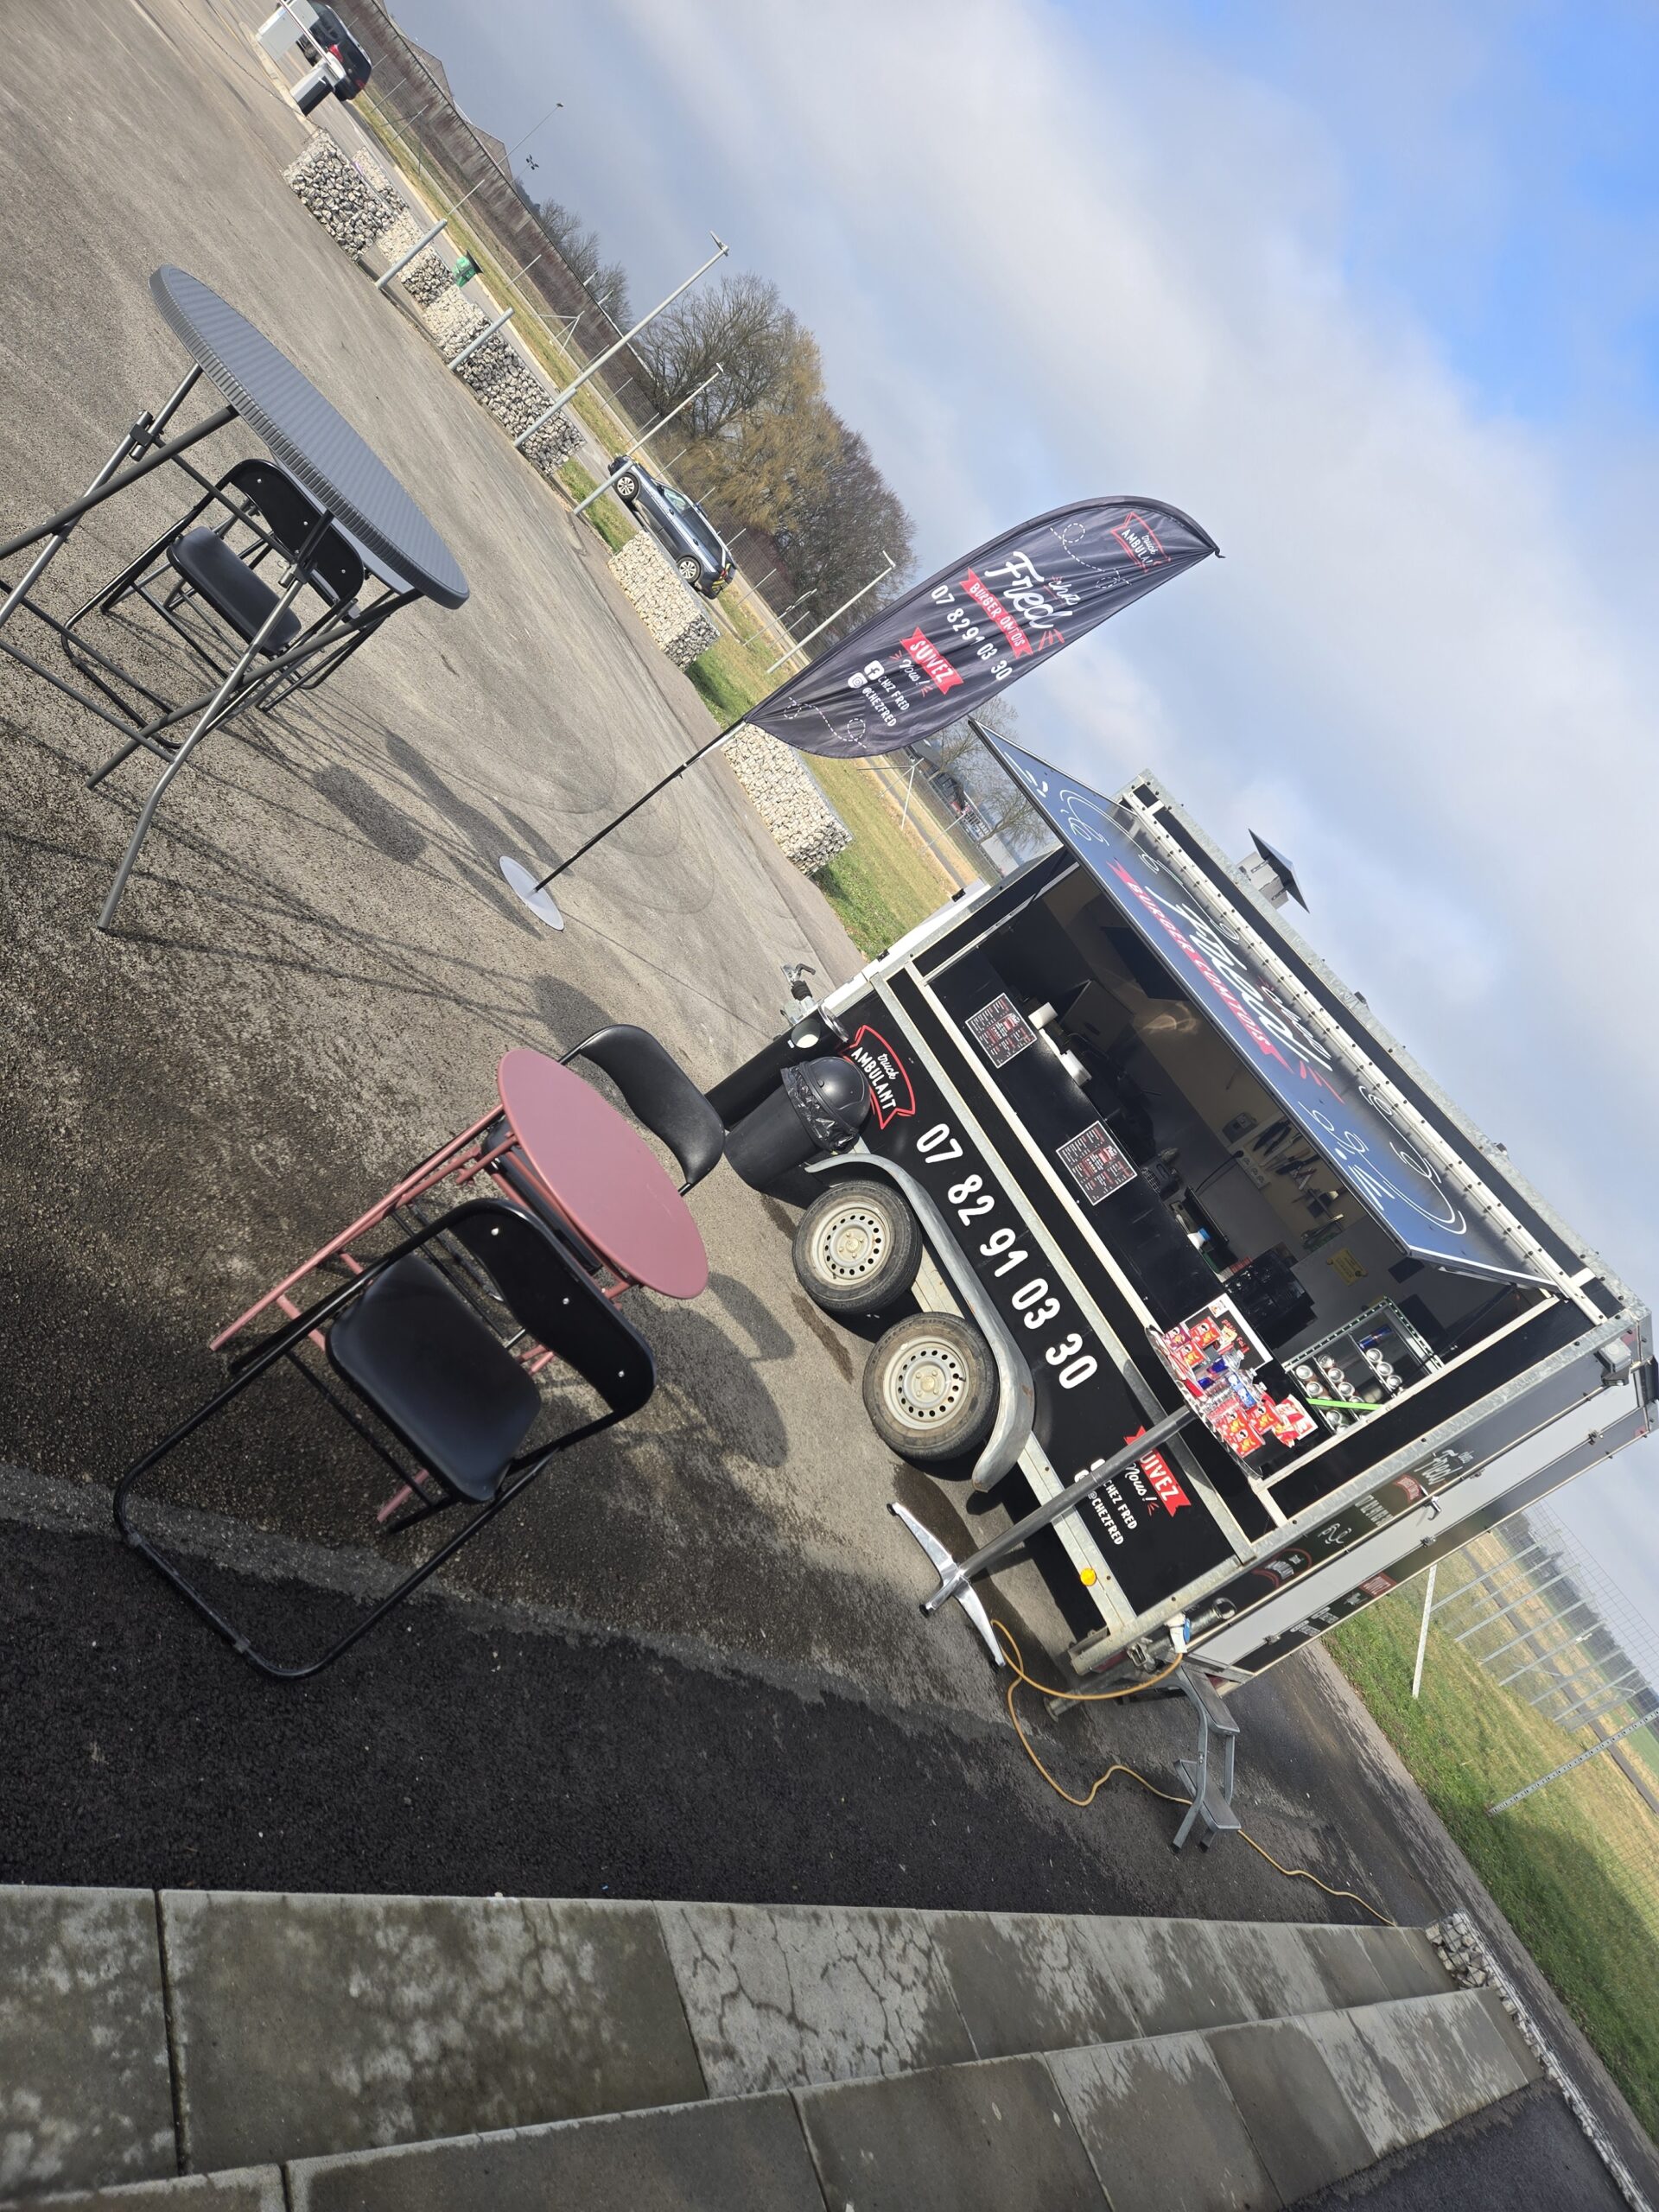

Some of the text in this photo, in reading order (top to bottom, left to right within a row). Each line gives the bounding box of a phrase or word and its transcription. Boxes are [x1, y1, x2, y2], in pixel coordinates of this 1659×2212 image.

[969, 582, 1001, 618] BURGER
[984, 550, 1073, 629] Fred
[931, 584, 955, 605] 07
[976, 642, 998, 661] 03
[990, 659, 1013, 682] 30
[909, 639, 955, 683] SUIVEZ
[891, 690, 911, 712] FRED
[1127, 881, 1271, 1047] BURGER COMTOIS
[1144, 886, 1333, 1071] Fred
[851, 1046, 897, 1109] AMBULANT
[877, 1052, 899, 1080] truck
[916, 1122, 1098, 1389] 07 82 91 03 30
[1139, 1450, 1179, 1502] UIVEZ
[1414, 1449, 1464, 1485] Fred
[1087, 1491, 1124, 1545] @CHEZFRED
[1103, 1479, 1138, 1529] CHEZ FRED
